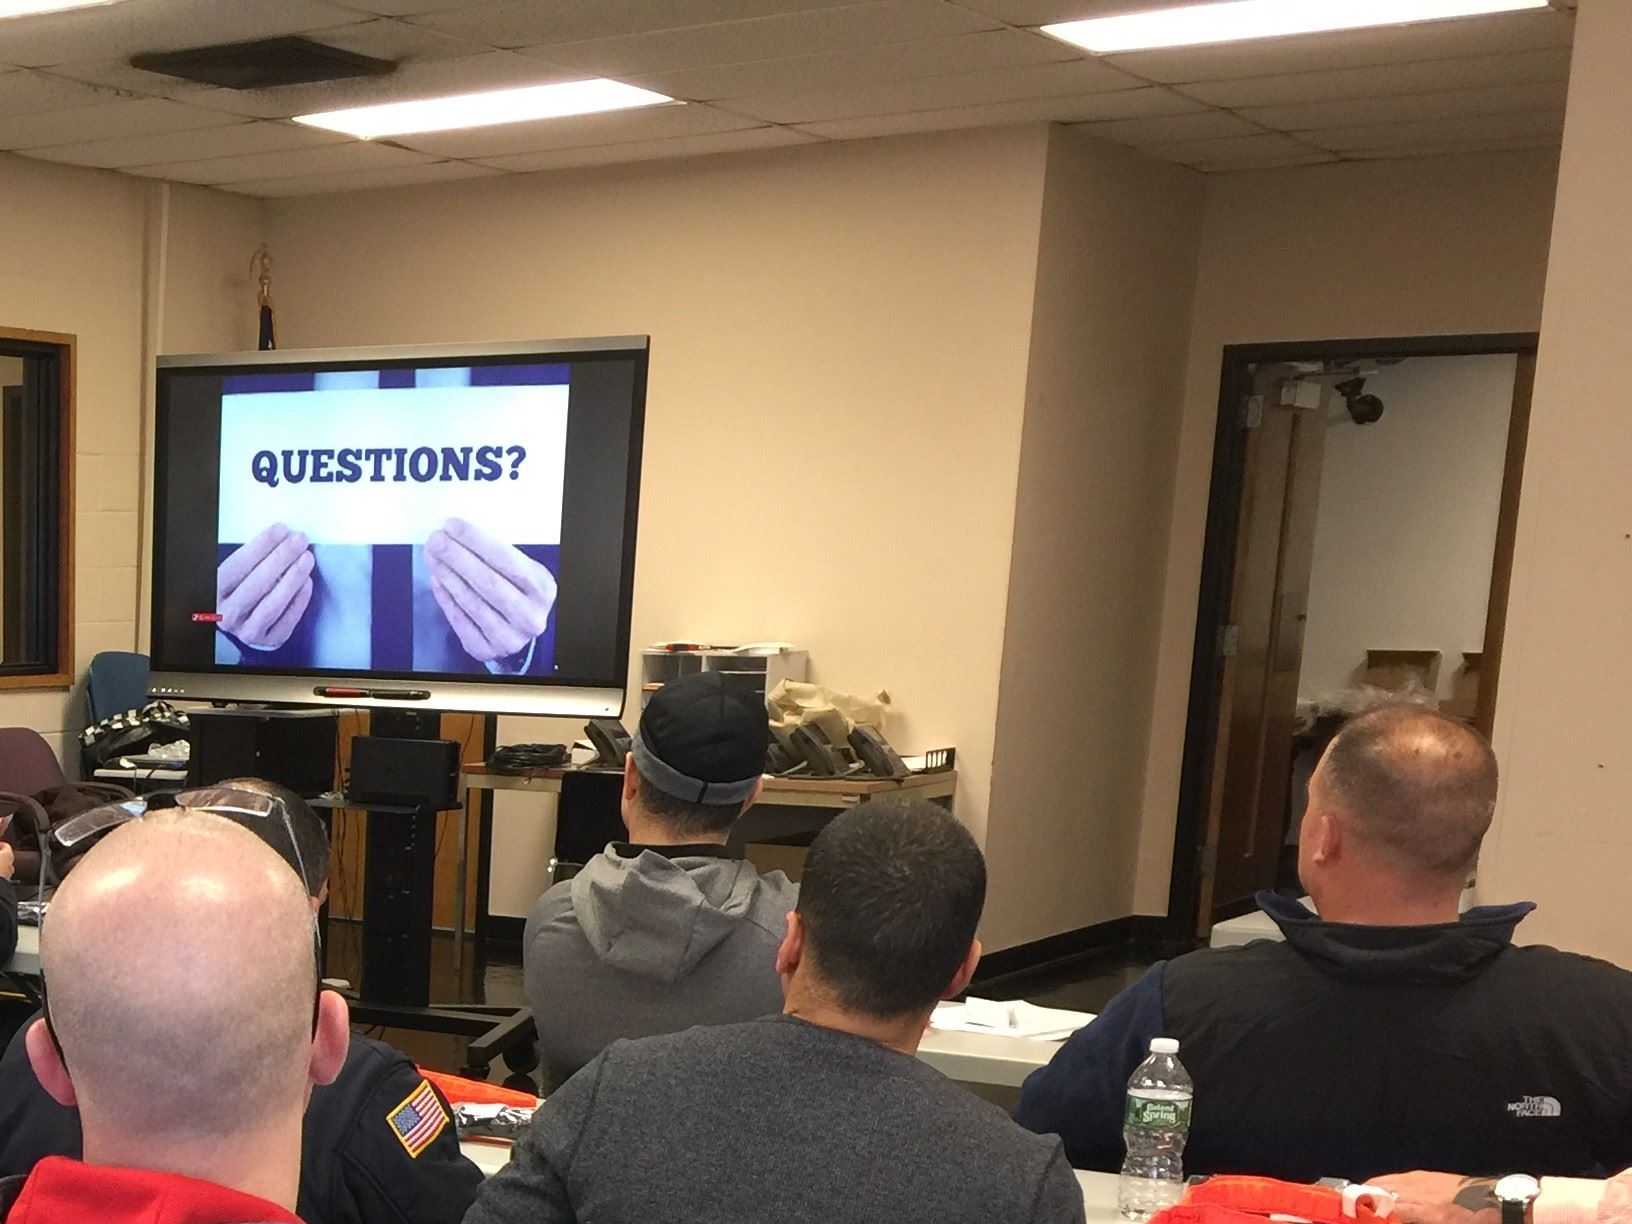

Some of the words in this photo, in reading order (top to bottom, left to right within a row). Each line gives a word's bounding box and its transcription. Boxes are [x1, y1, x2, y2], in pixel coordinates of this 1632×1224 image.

[252, 446, 526, 487] QUESTIONS?
[1507, 1102, 1542, 1112] NORTH
[1142, 1110, 1177, 1125] Spring
